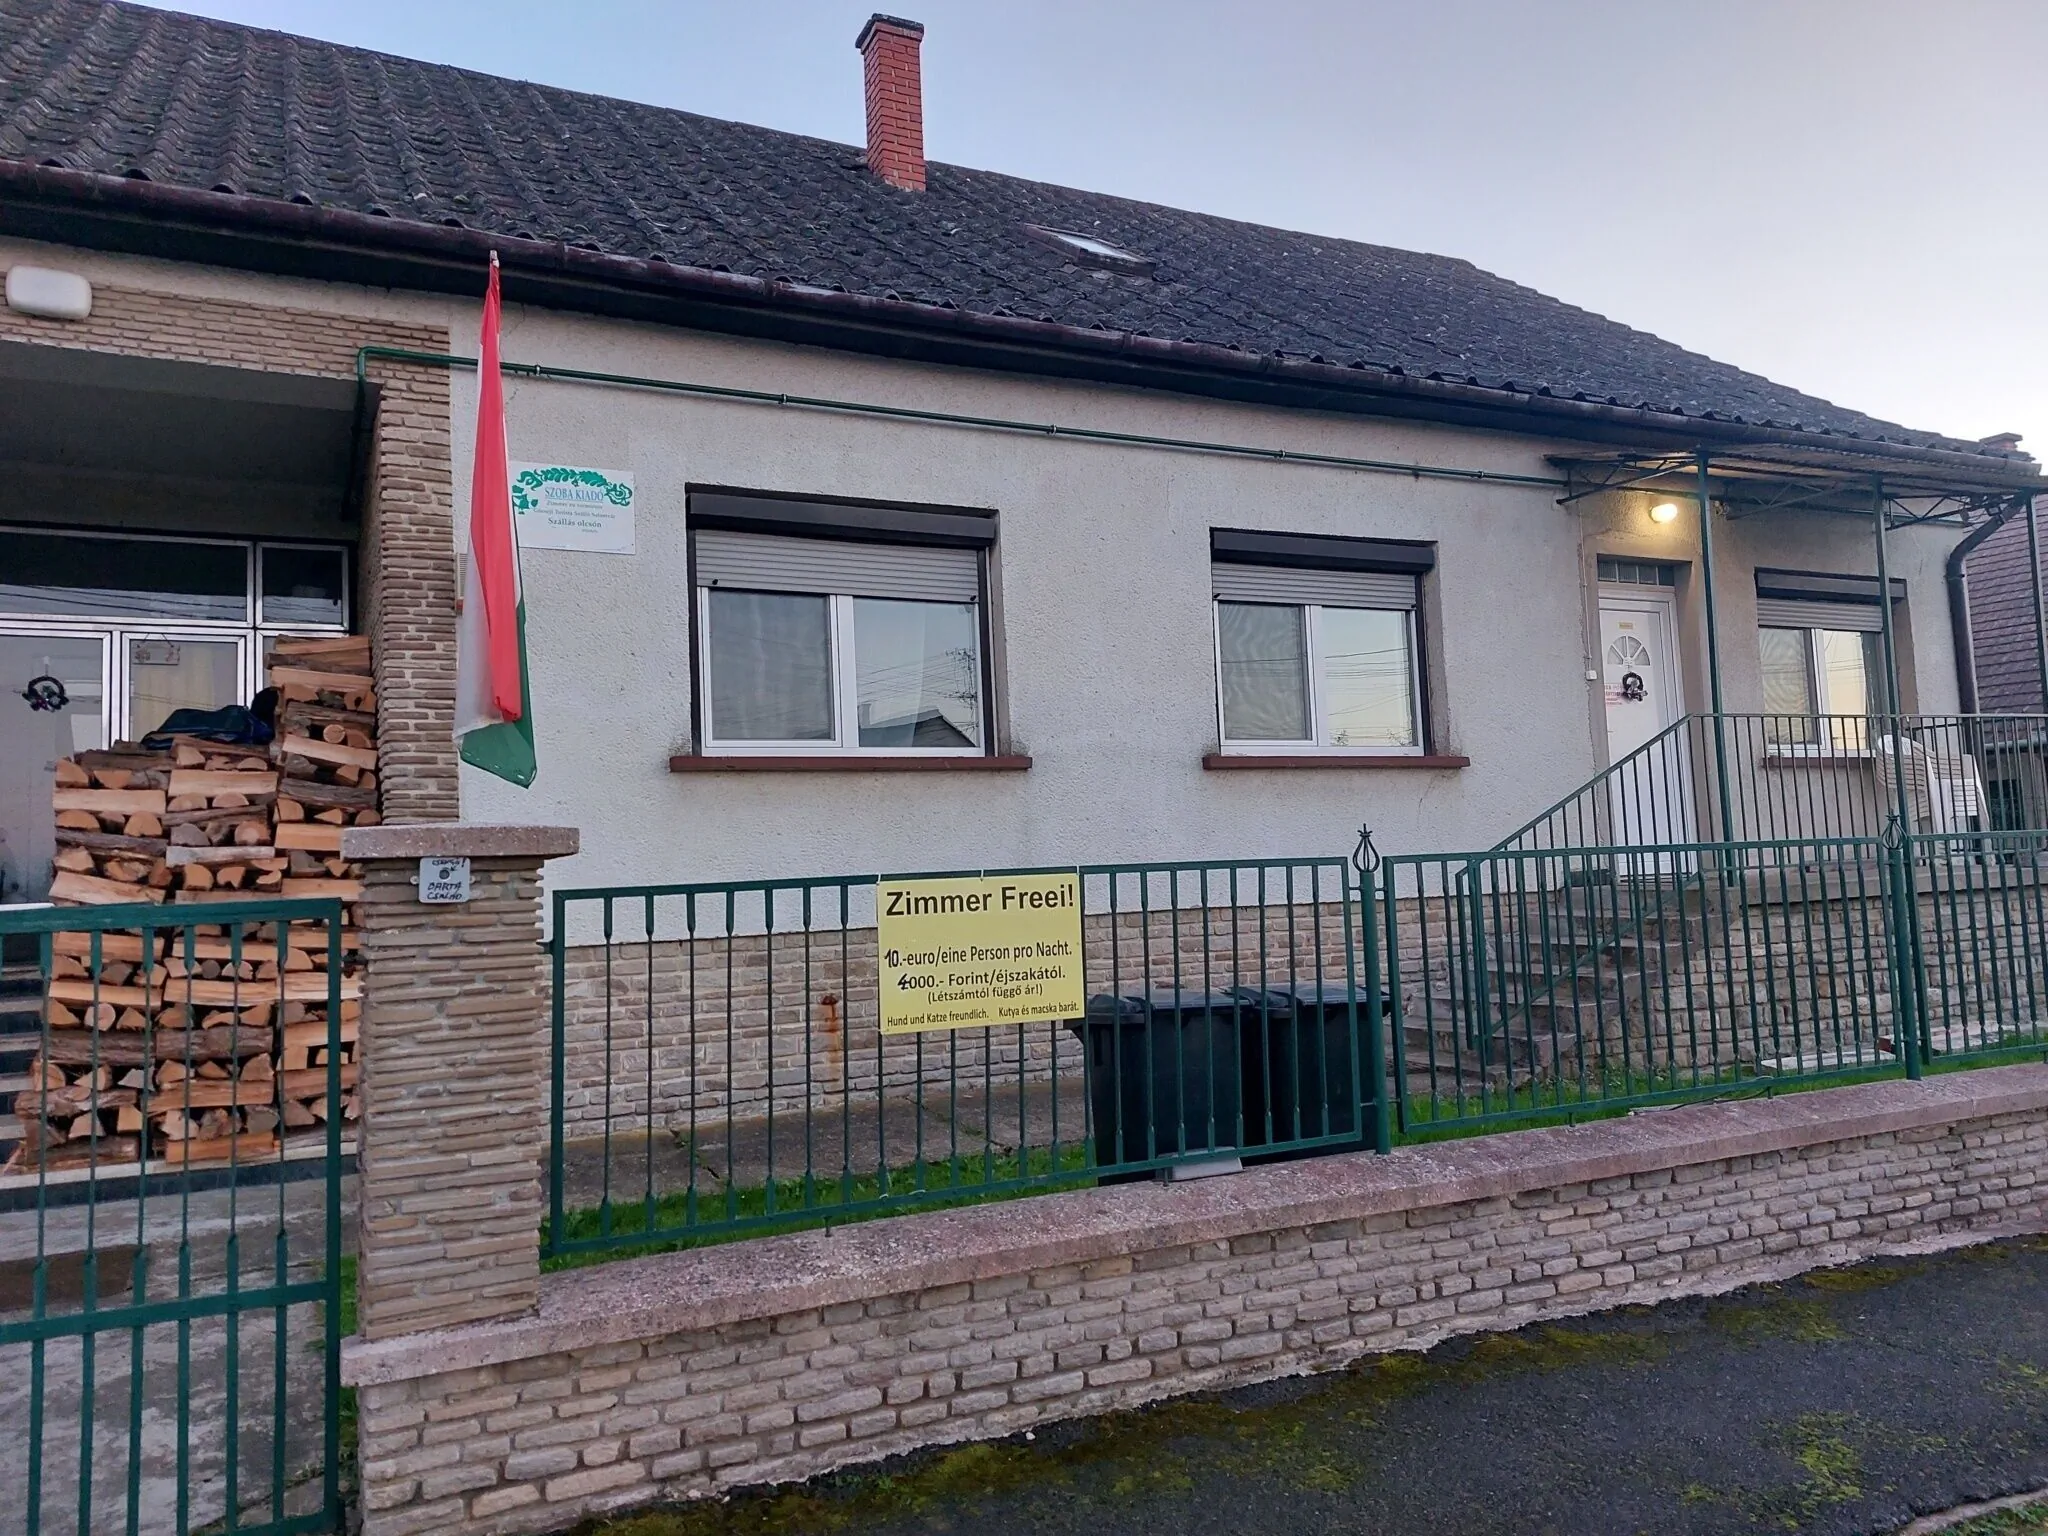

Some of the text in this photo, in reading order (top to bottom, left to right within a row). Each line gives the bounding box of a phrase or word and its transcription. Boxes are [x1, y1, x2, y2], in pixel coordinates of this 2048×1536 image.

[545, 487, 604, 501] SZOBA KIADÓ
[548, 518, 602, 528] Szállás olcsón
[886, 883, 1075, 916] Zimmer Freei!
[970, 944, 1010, 962] Person
[1013, 946, 1033, 962] pro
[1036, 940, 1072, 957] Nacht.
[897, 966, 1066, 991] 4000.- Forint/éjszakától.
[927, 983, 1044, 1004] (Létszámtól függő ár!)
[887, 1010, 990, 1027] Hund und Katze freundlich.
[998, 1001, 1080, 1018] Kutya és macska barát.
